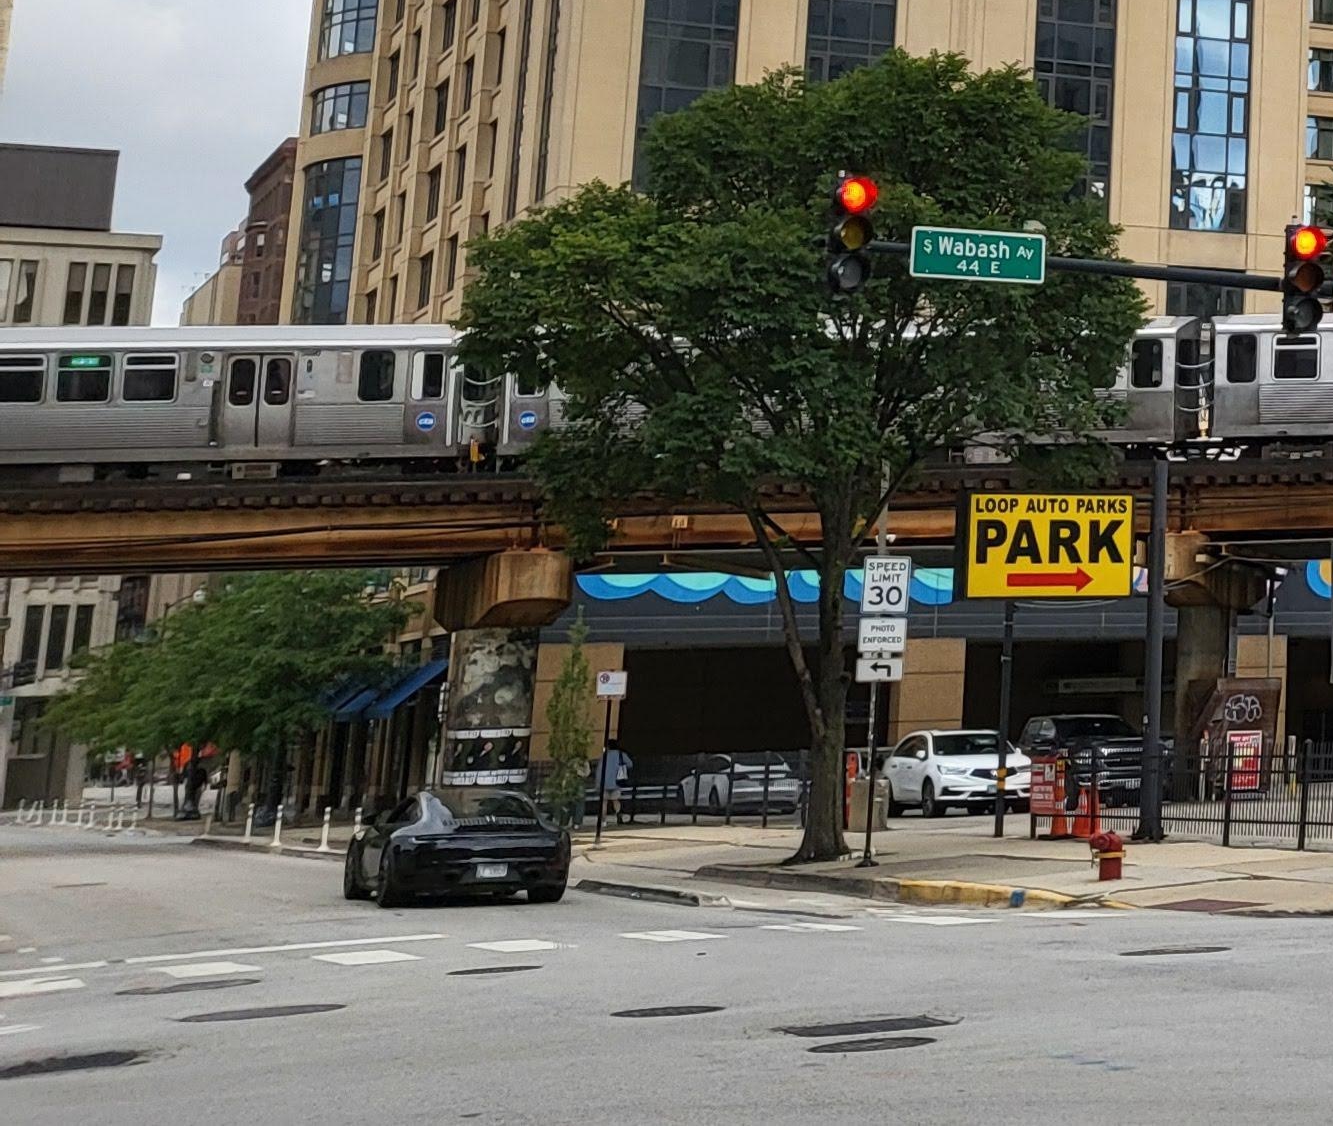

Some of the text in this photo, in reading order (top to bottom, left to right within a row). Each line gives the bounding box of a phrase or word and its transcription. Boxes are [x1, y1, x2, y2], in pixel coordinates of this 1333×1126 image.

[923, 239, 933, 254] S
[938, 235, 1010, 260] Wabash
[956, 259, 1001, 275] 44 E
[975, 498, 1128, 514] LOOP AUTO PARKS
[975, 519, 1125, 565] PARK
[868, 562, 906, 571] SPEED
[871, 574, 901, 583] LIMIT
[868, 585, 902, 606] 30
[870, 624, 895, 633] PHOTO
[862, 636, 902, 644] ENFORCED
